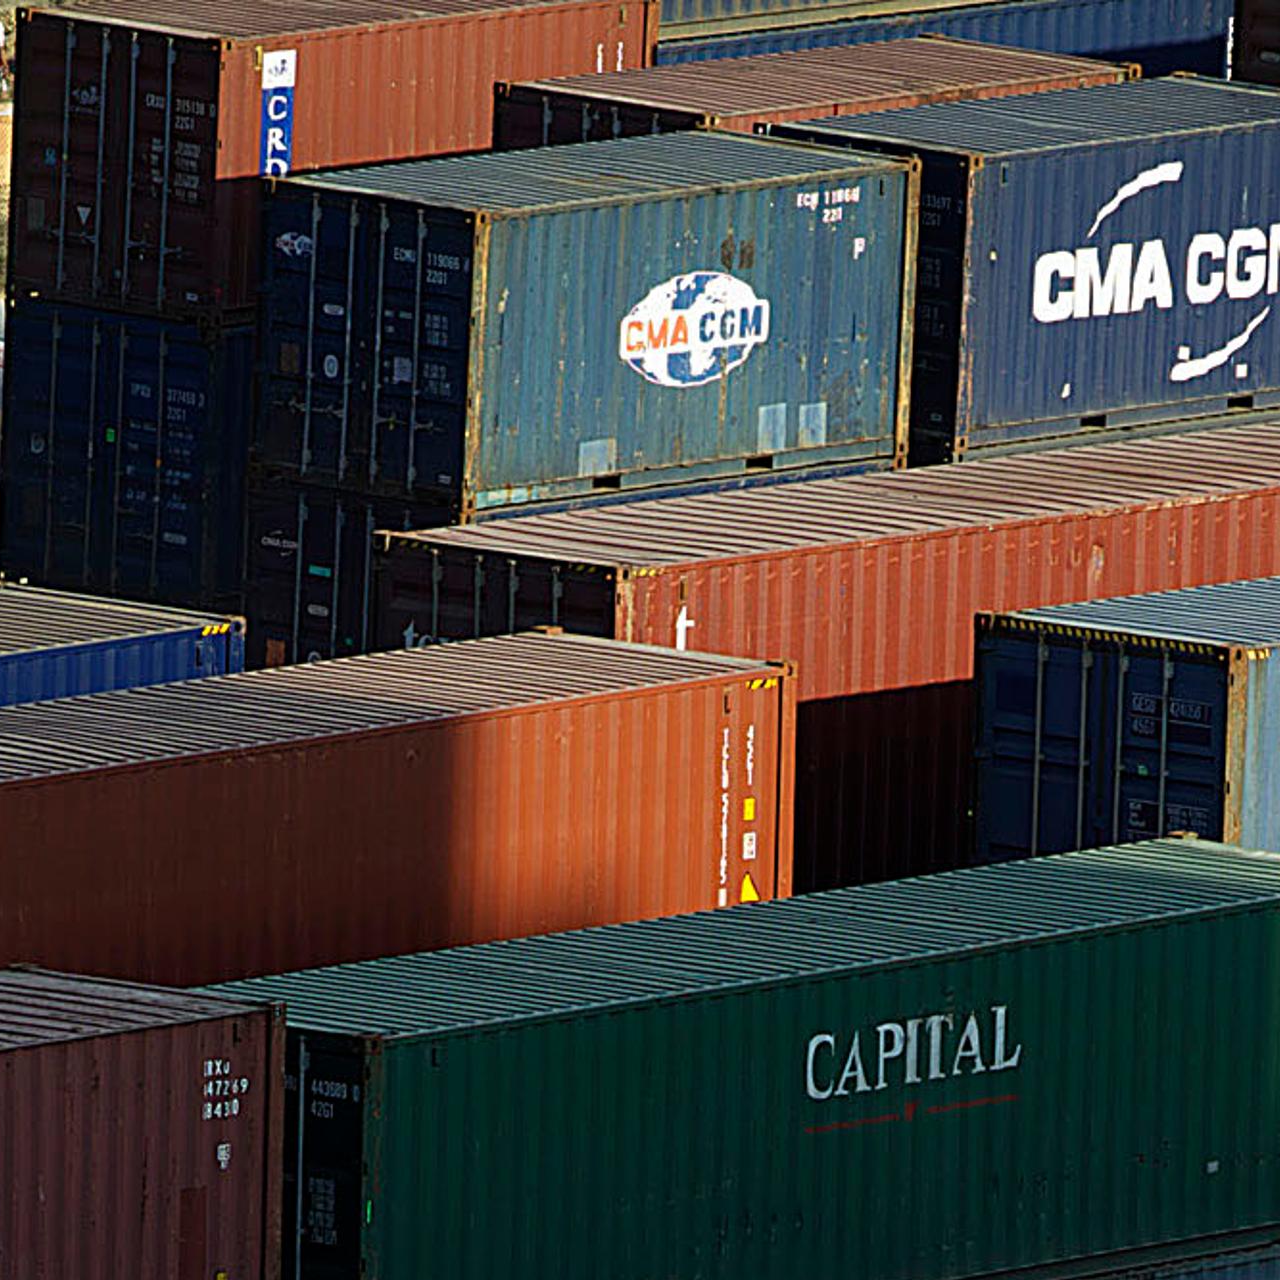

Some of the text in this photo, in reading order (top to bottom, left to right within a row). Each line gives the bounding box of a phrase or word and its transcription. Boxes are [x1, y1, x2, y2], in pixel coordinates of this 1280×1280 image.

[1031, 239, 1173, 323] CMA
[625, 303, 764, 355] CMA CGM
[805, 1005, 1020, 1101] CAPITAL
